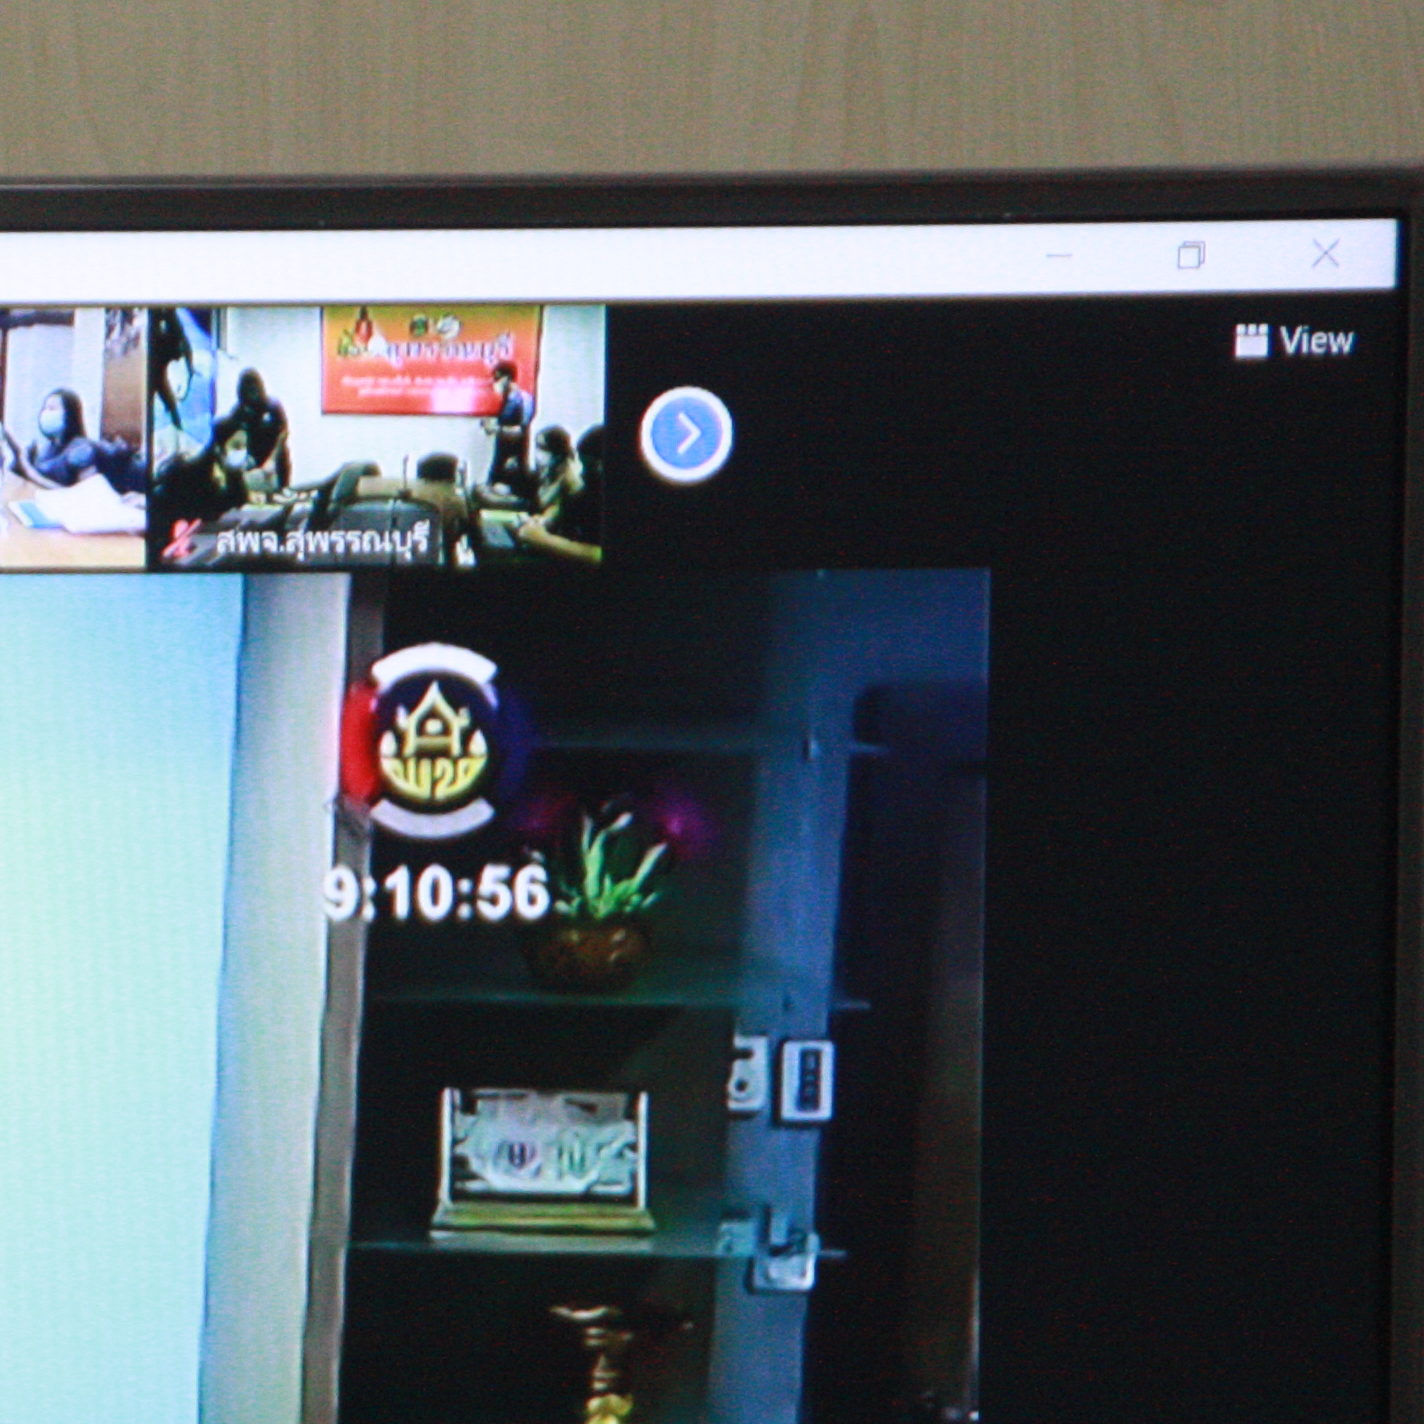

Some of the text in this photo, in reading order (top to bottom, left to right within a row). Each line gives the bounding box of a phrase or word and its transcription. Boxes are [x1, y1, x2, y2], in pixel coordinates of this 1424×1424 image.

[1280, 325, 1355, 356] View
[216, 519, 431, 562] สพจ.สุพรรณบุรี
[323, 864, 550, 921] 9:10:56
